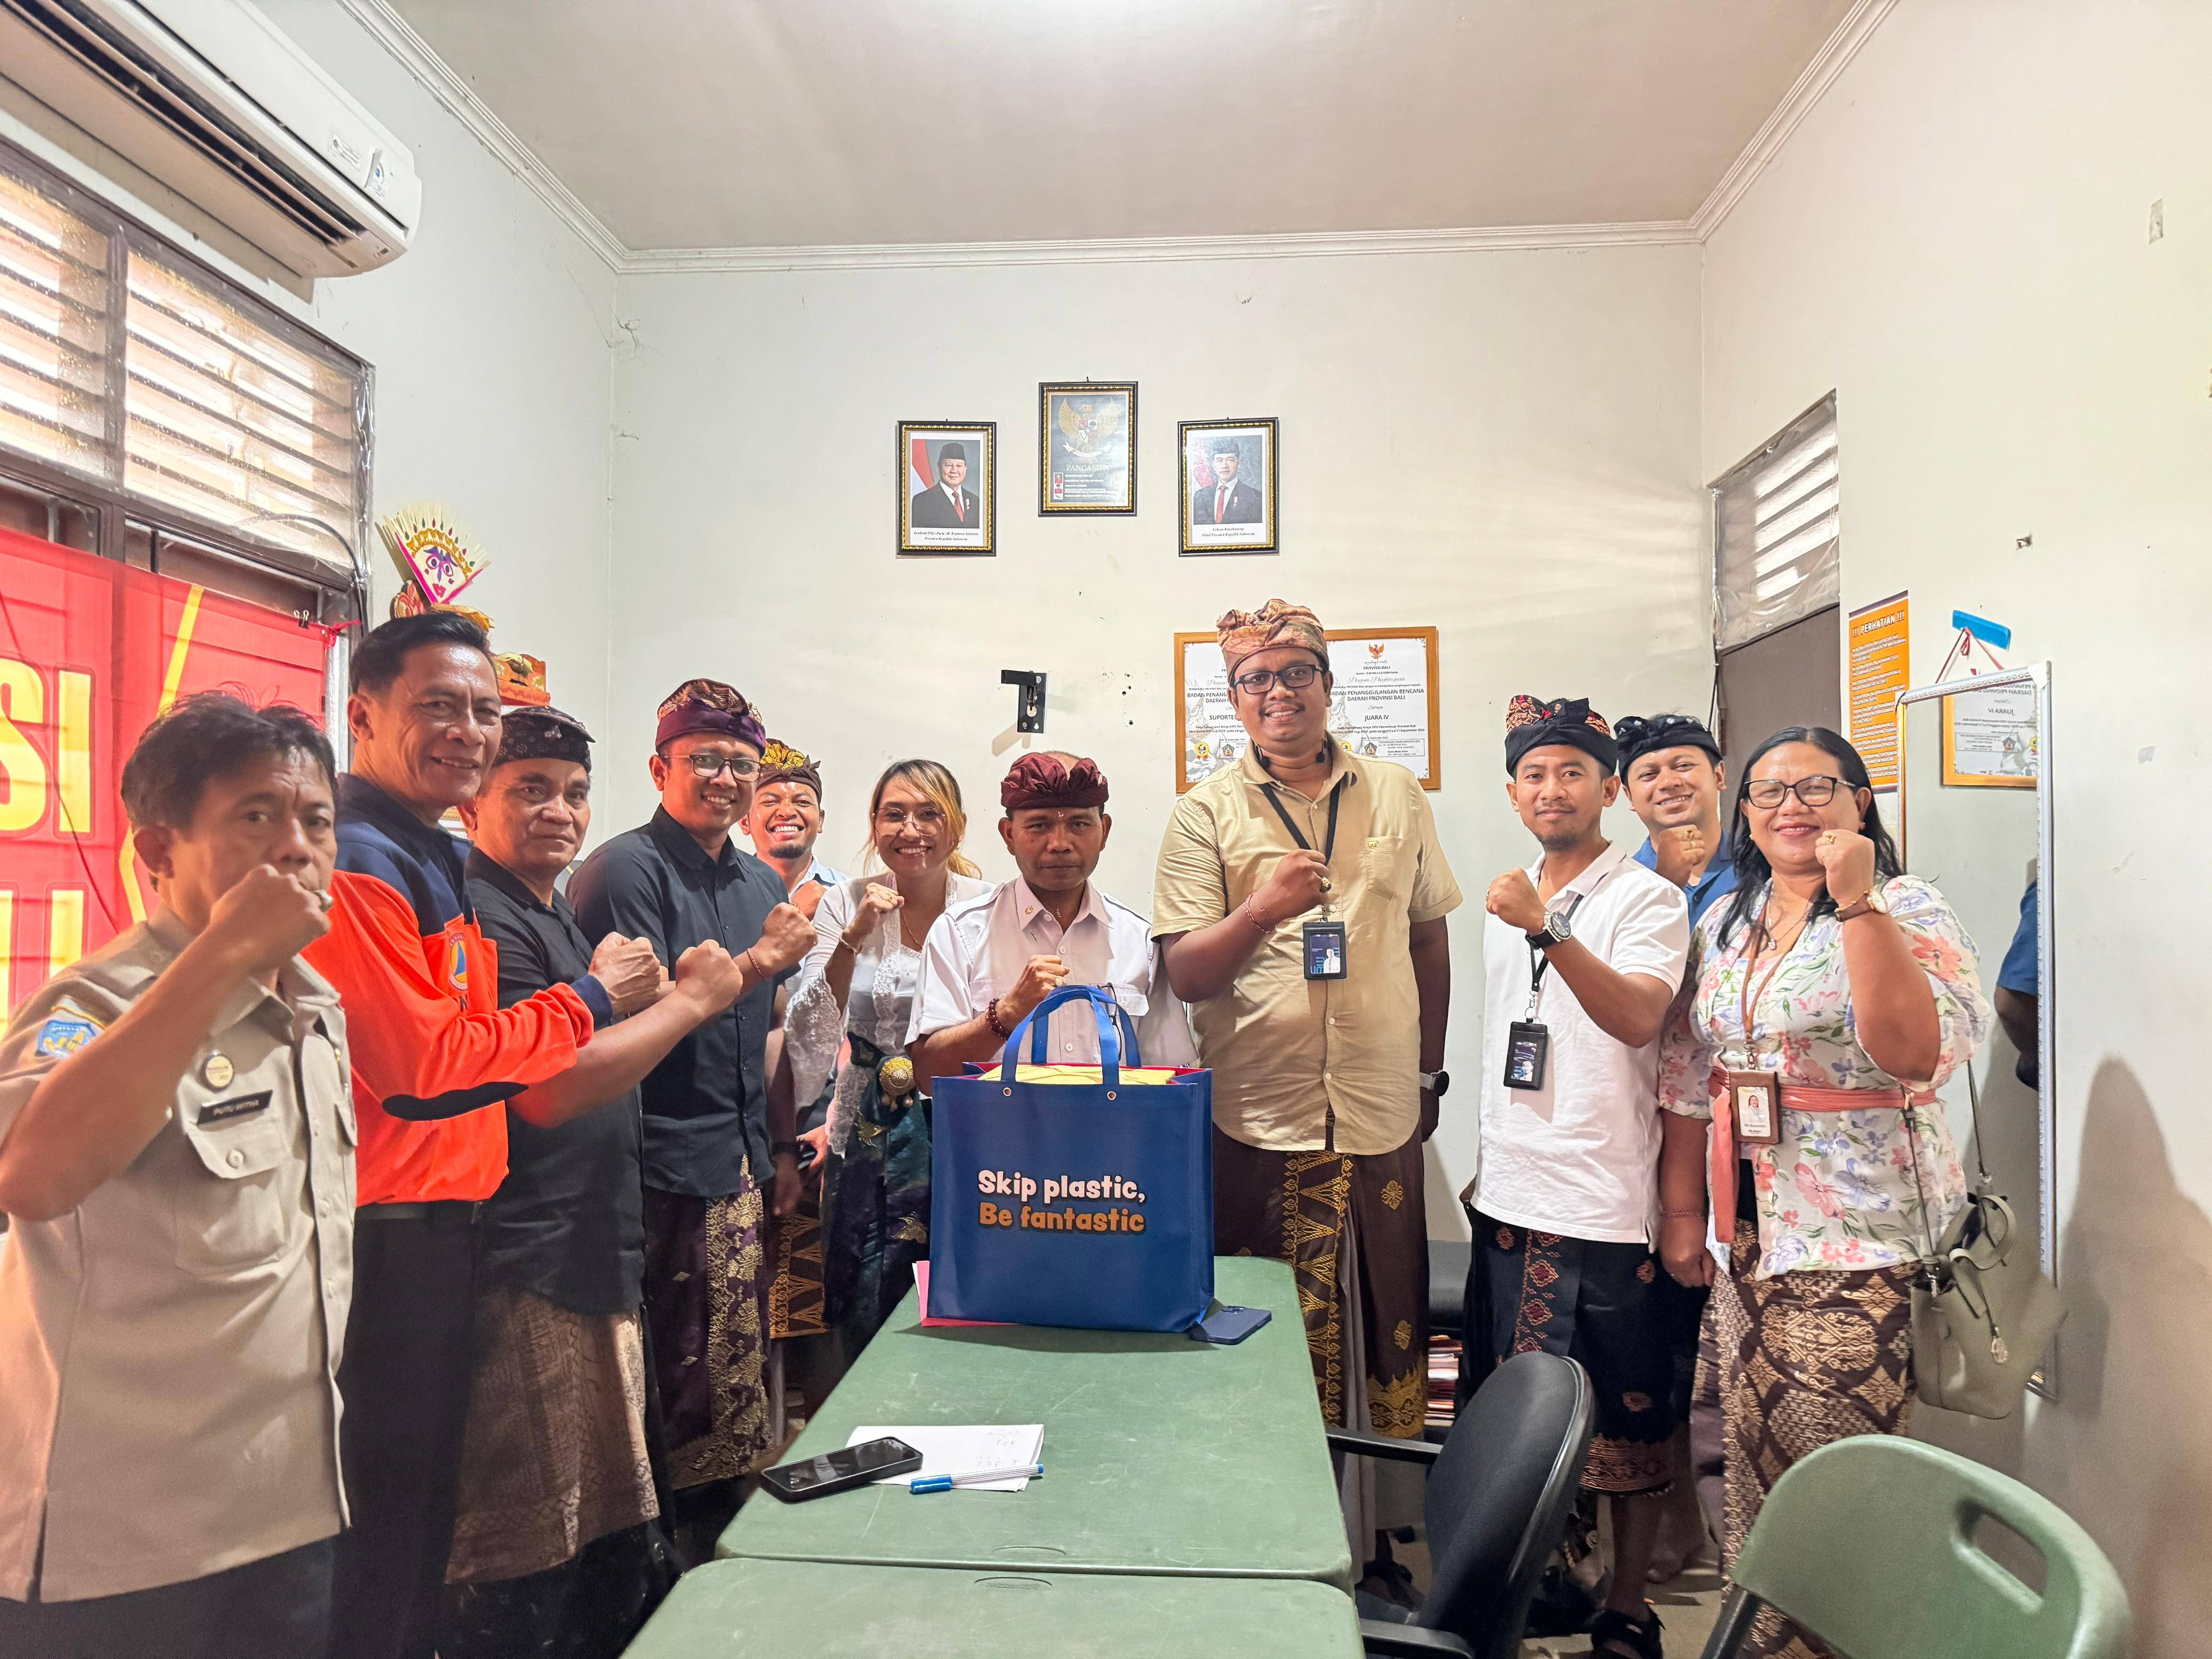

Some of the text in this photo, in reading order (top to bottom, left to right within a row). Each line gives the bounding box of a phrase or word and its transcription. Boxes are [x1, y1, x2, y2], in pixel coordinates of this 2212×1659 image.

[1861, 614, 1896, 634] PERHATIAN
[978, 1169, 1146, 1204] Skip plastic,
[979, 1202, 1144, 1232] Be fantastic
